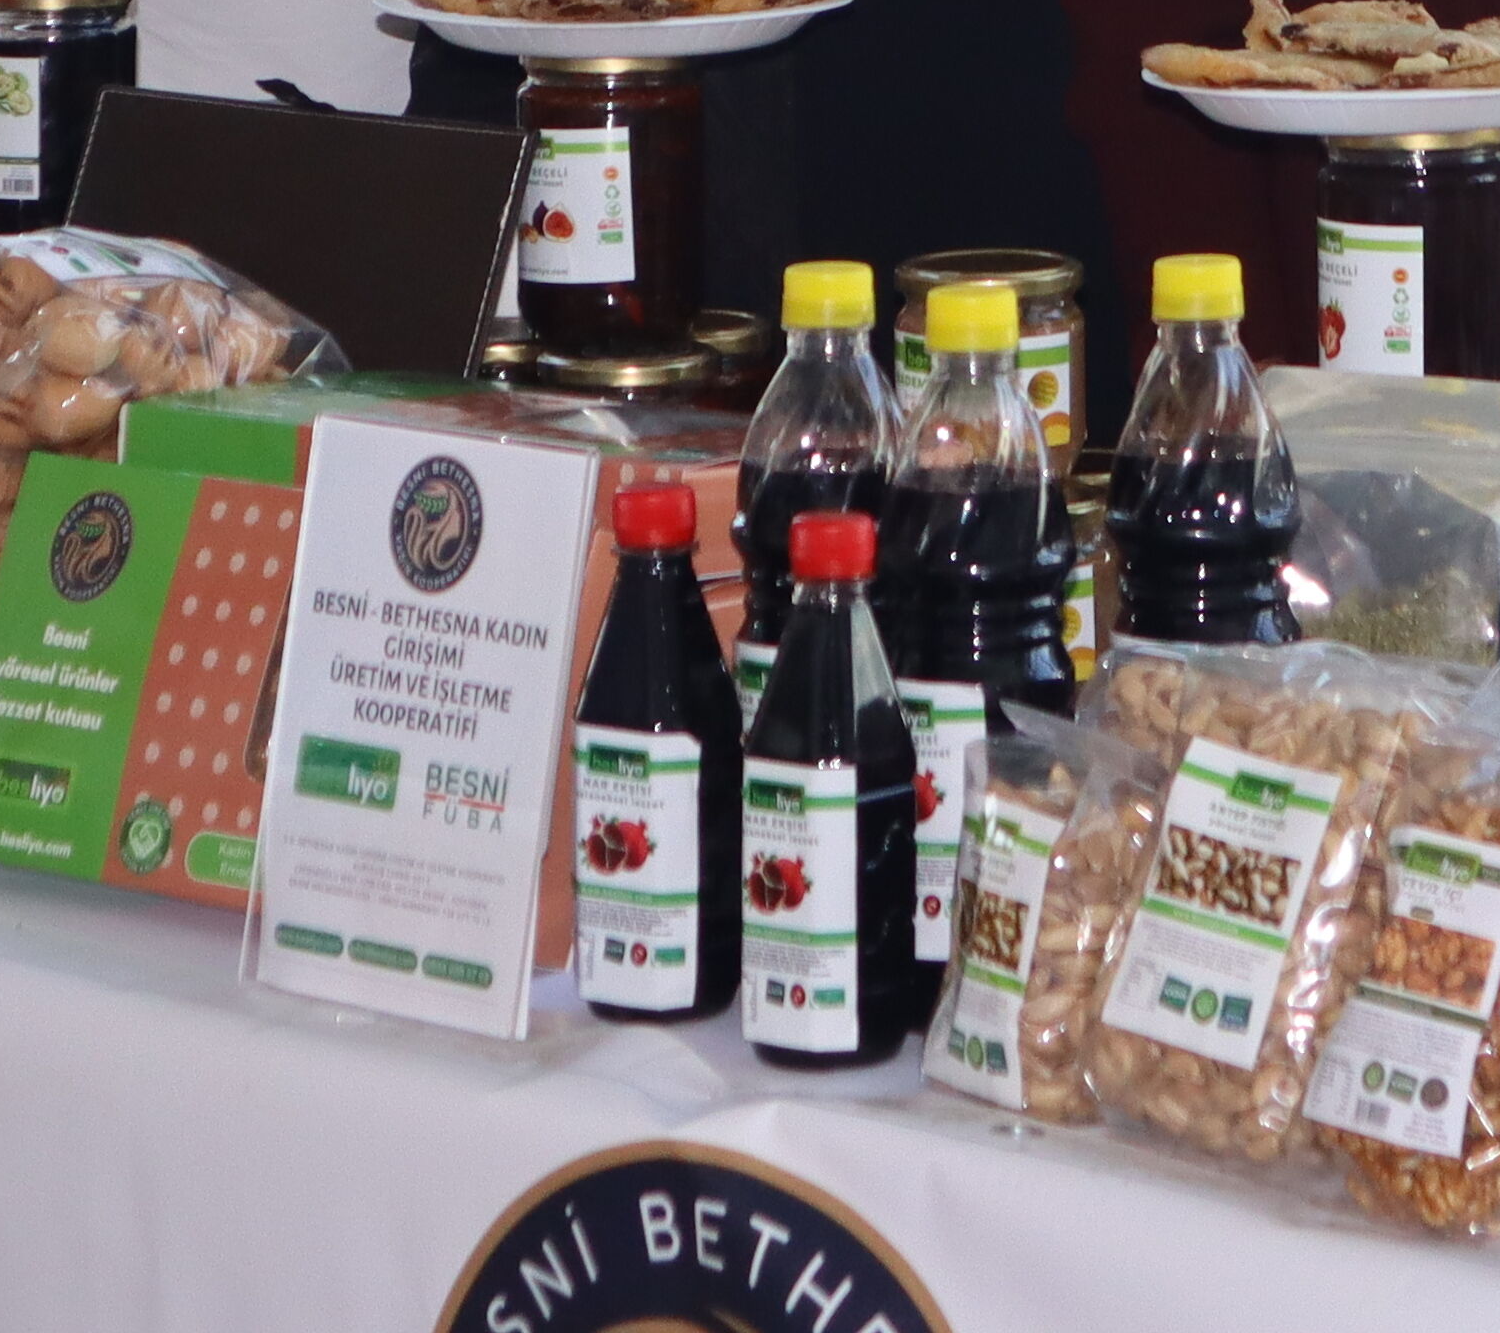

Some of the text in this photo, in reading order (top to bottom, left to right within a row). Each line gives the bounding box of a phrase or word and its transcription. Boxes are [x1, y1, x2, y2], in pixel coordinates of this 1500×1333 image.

[42, 621, 92, 651] Besni
[312, 589, 369, 621] BESNİ
[381, 600, 480, 638] BETHESNA
[485, 619, 549, 651] KADIN
[383, 633, 466, 670] GİRİŞİMİ
[58, 663, 119, 694] ürünler
[329, 653, 514, 714] ÜRETİM VE İŞLETME
[44, 701, 103, 731] kutusu
[352, 697, 479, 742] KOOPERATİFİ
[424, 762, 511, 805] BESNİ
[486, 1201, 598, 1333] SNİ
